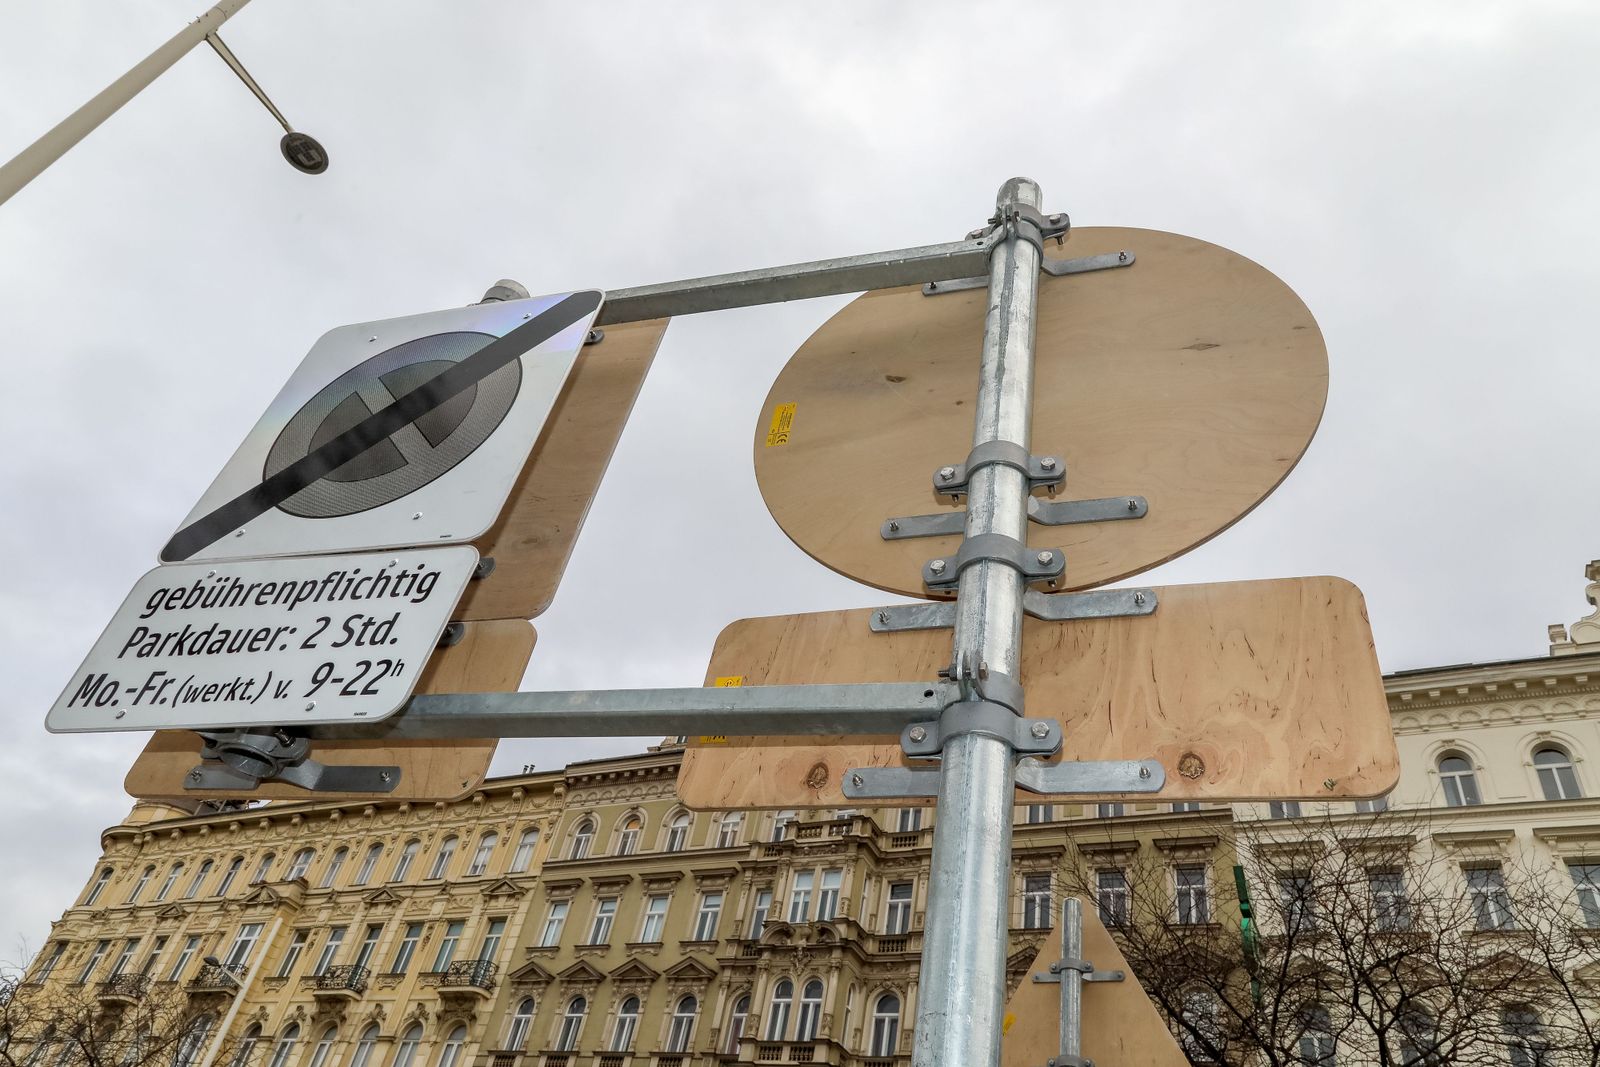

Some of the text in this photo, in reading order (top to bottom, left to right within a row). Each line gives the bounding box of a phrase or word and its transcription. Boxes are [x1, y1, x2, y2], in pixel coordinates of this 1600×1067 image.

[139, 563, 441, 619] gebührenpflichtig
[117, 612, 401, 659] Parkdauer: 2 Std.
[273, 679, 293, 699] v.
